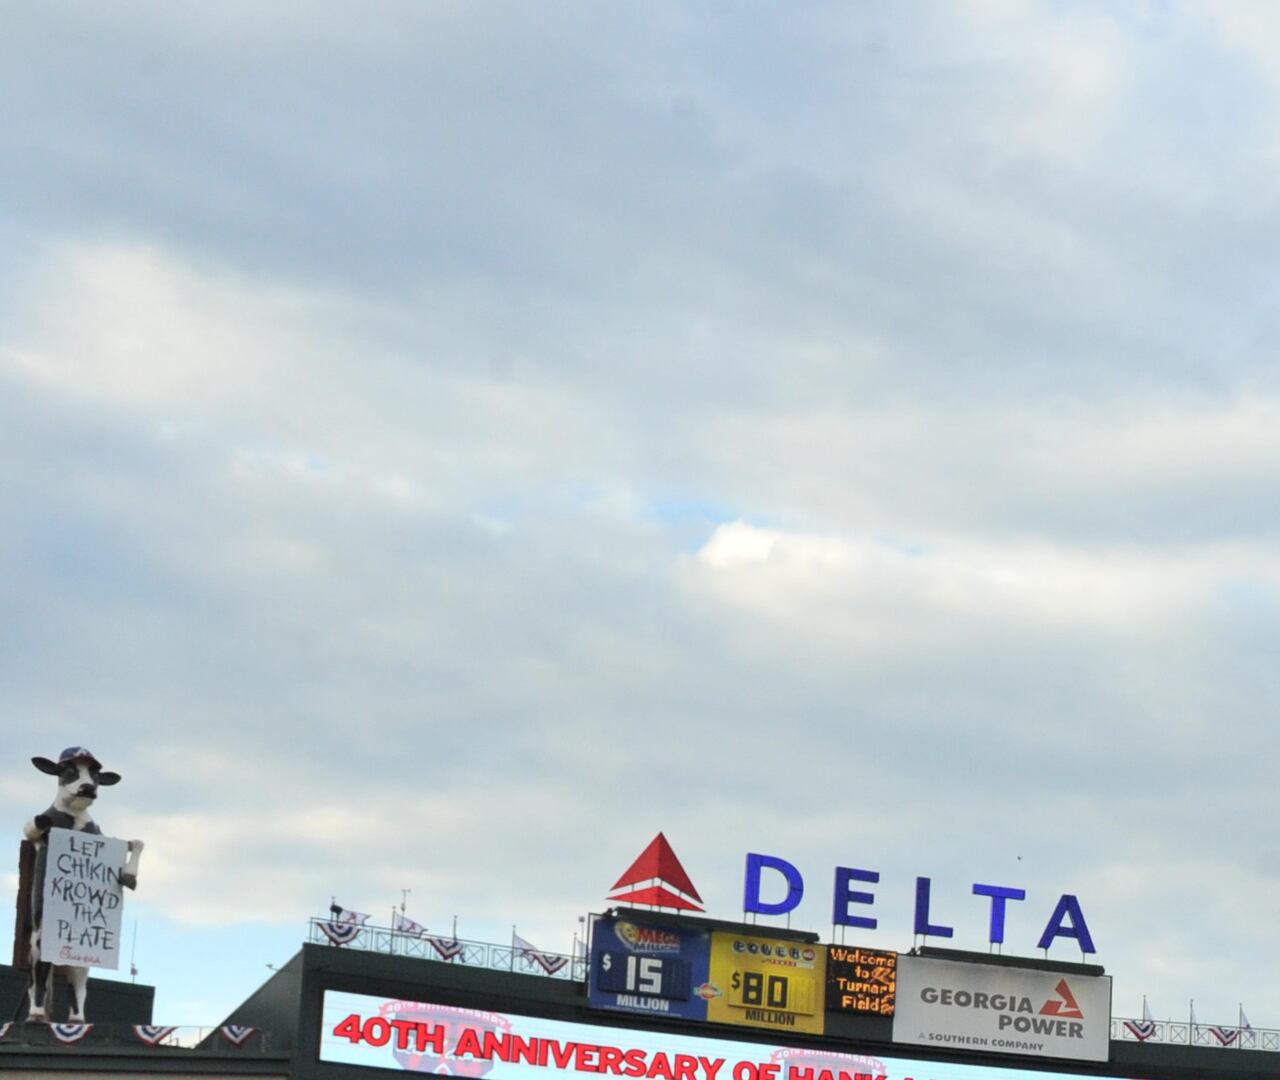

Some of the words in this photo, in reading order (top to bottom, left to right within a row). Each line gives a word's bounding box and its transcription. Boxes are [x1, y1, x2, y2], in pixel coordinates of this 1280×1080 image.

[70, 836, 105, 858] LET
[57, 854, 122, 885] CHIKIN
[51, 877, 119, 909] KROWD
[744, 853, 1096, 954] DELTA
[72, 902, 106, 925] THA
[57, 919, 114, 950] PLATE
[831, 948, 896, 968] Welcome
[616, 994, 669, 1012] MILLION
[920, 987, 1034, 1014] GEORGIA
[745, 1010, 795, 1026] MILLION
[998, 1015, 1084, 1038] POWER
[333, 1013, 444, 1055] 40TH
[928, 1032, 988, 1046] SOUTHERN
[991, 1038, 1044, 1051] COMPANY
